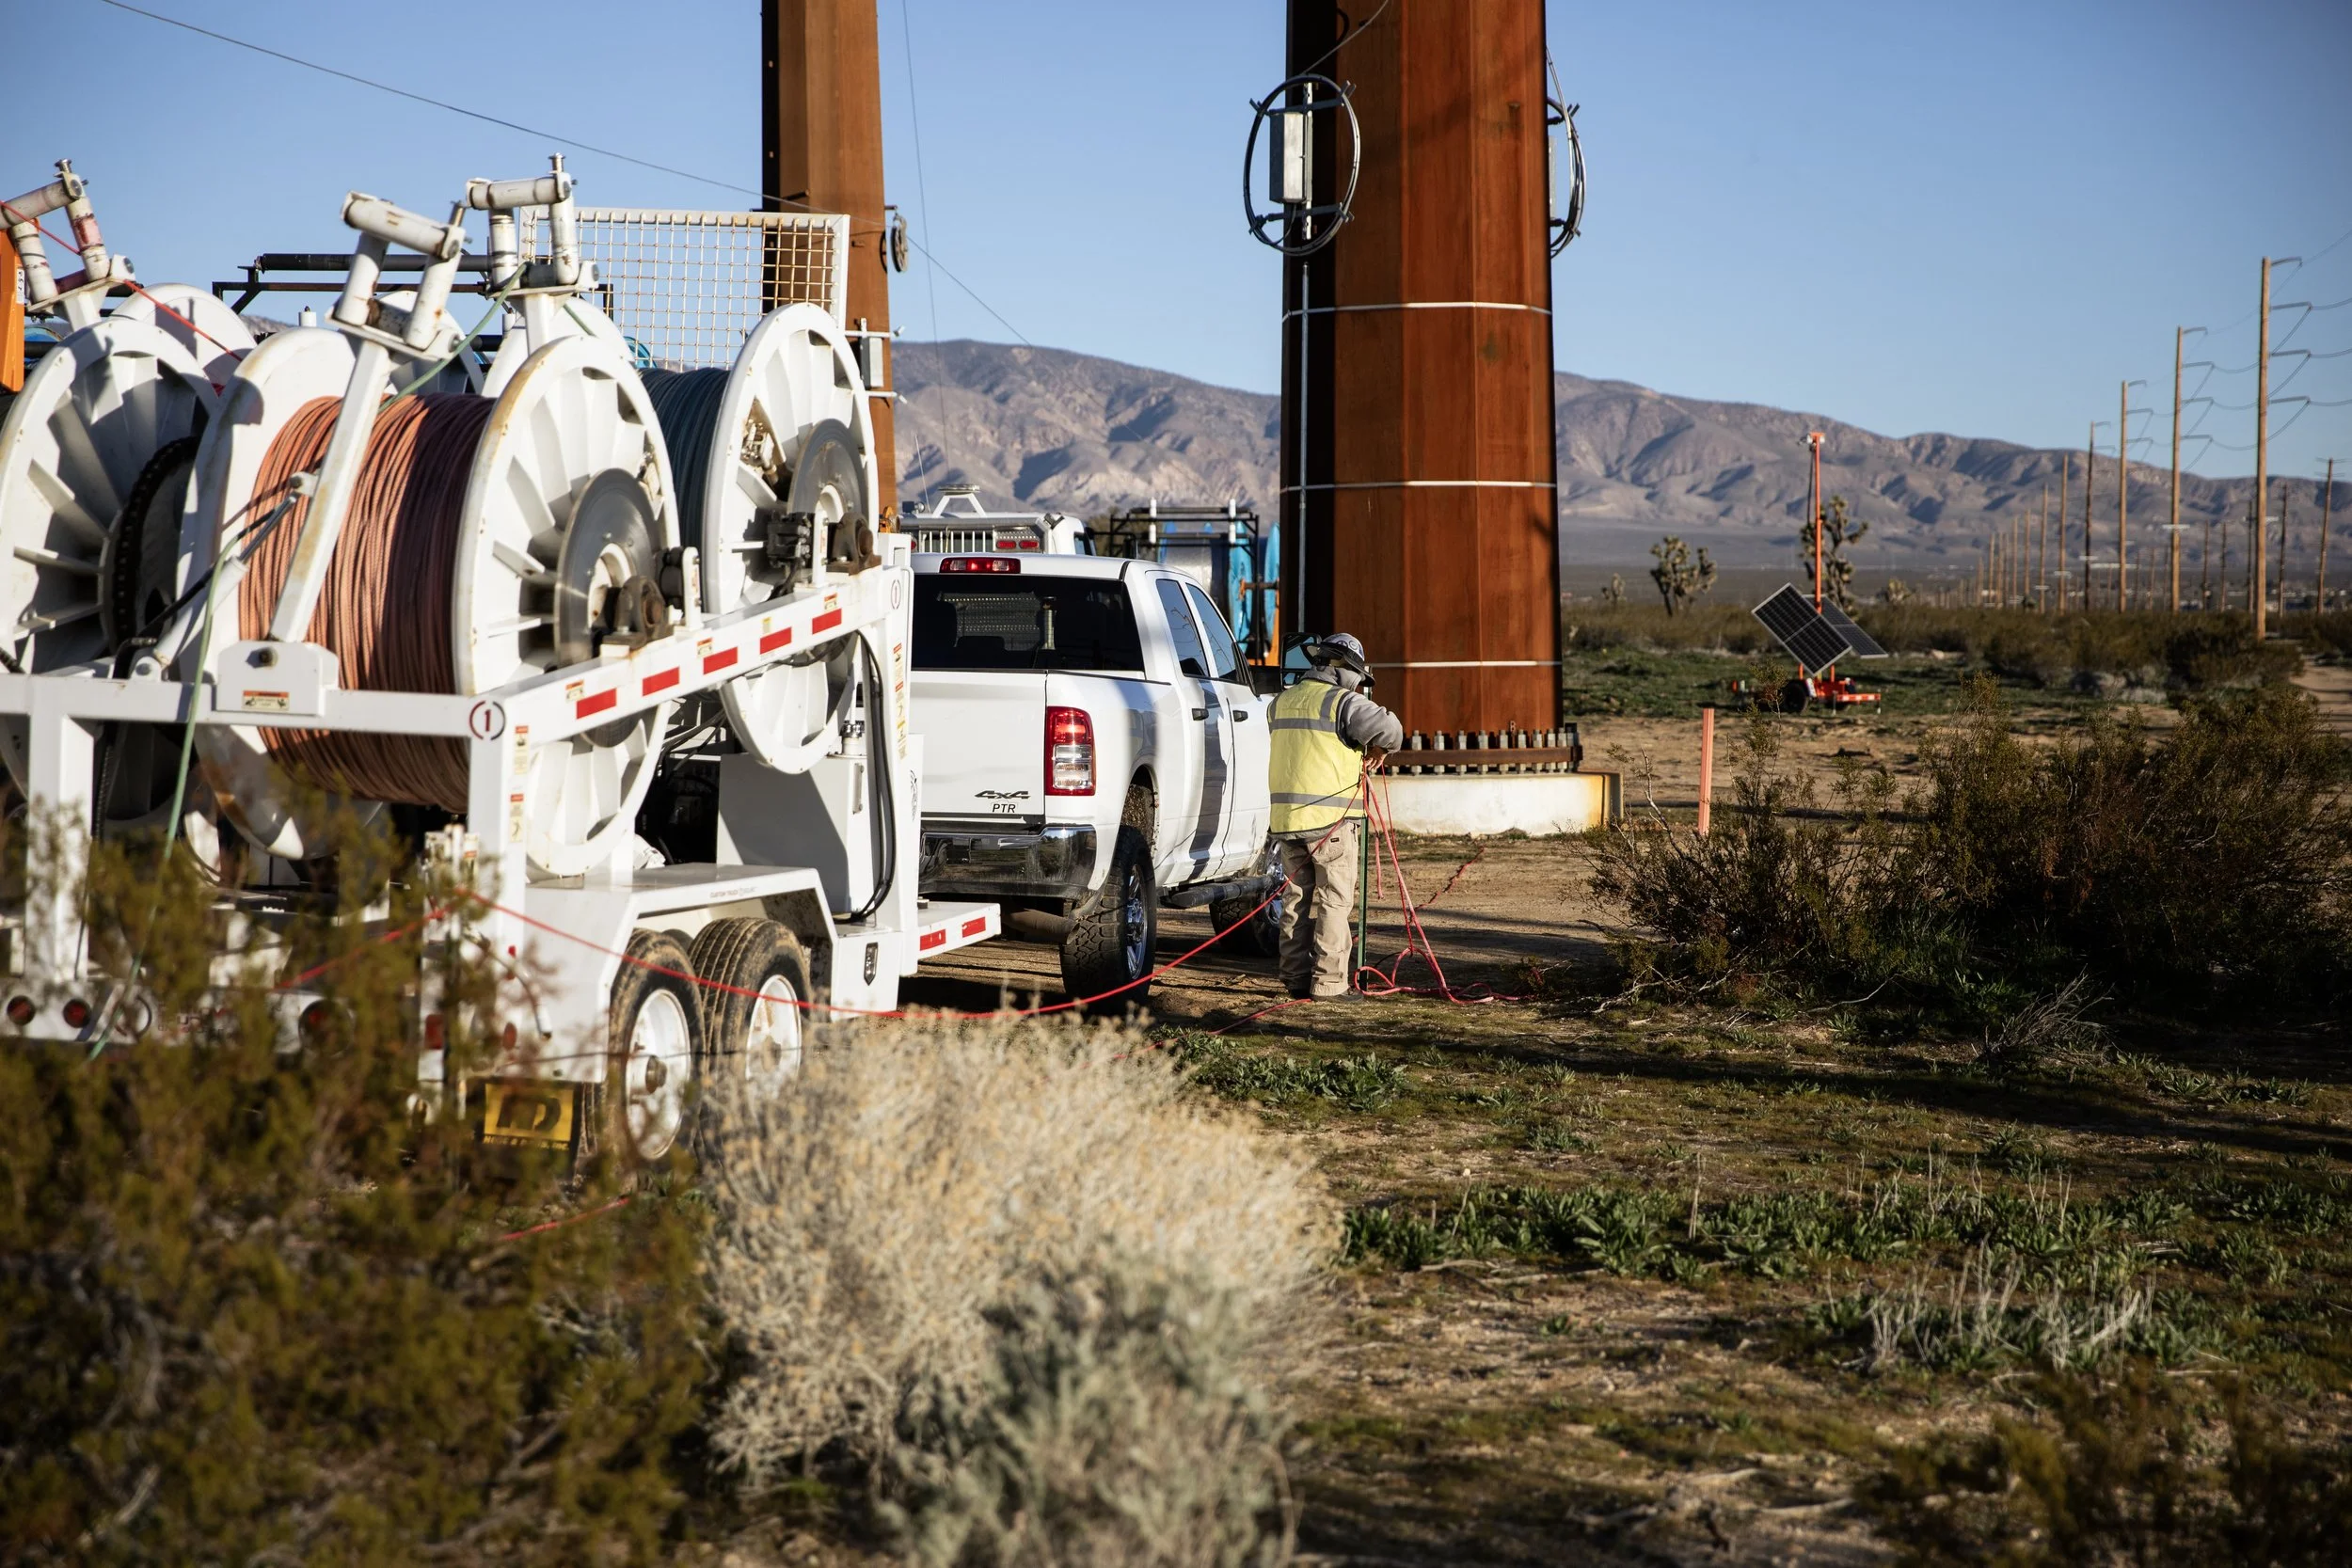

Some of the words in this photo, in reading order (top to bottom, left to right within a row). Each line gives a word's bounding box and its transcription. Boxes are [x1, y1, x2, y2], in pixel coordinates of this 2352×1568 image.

[485, 708, 491, 733] 1
[974, 790, 1031, 800] 4x4
[992, 803, 1016, 814] PTR
